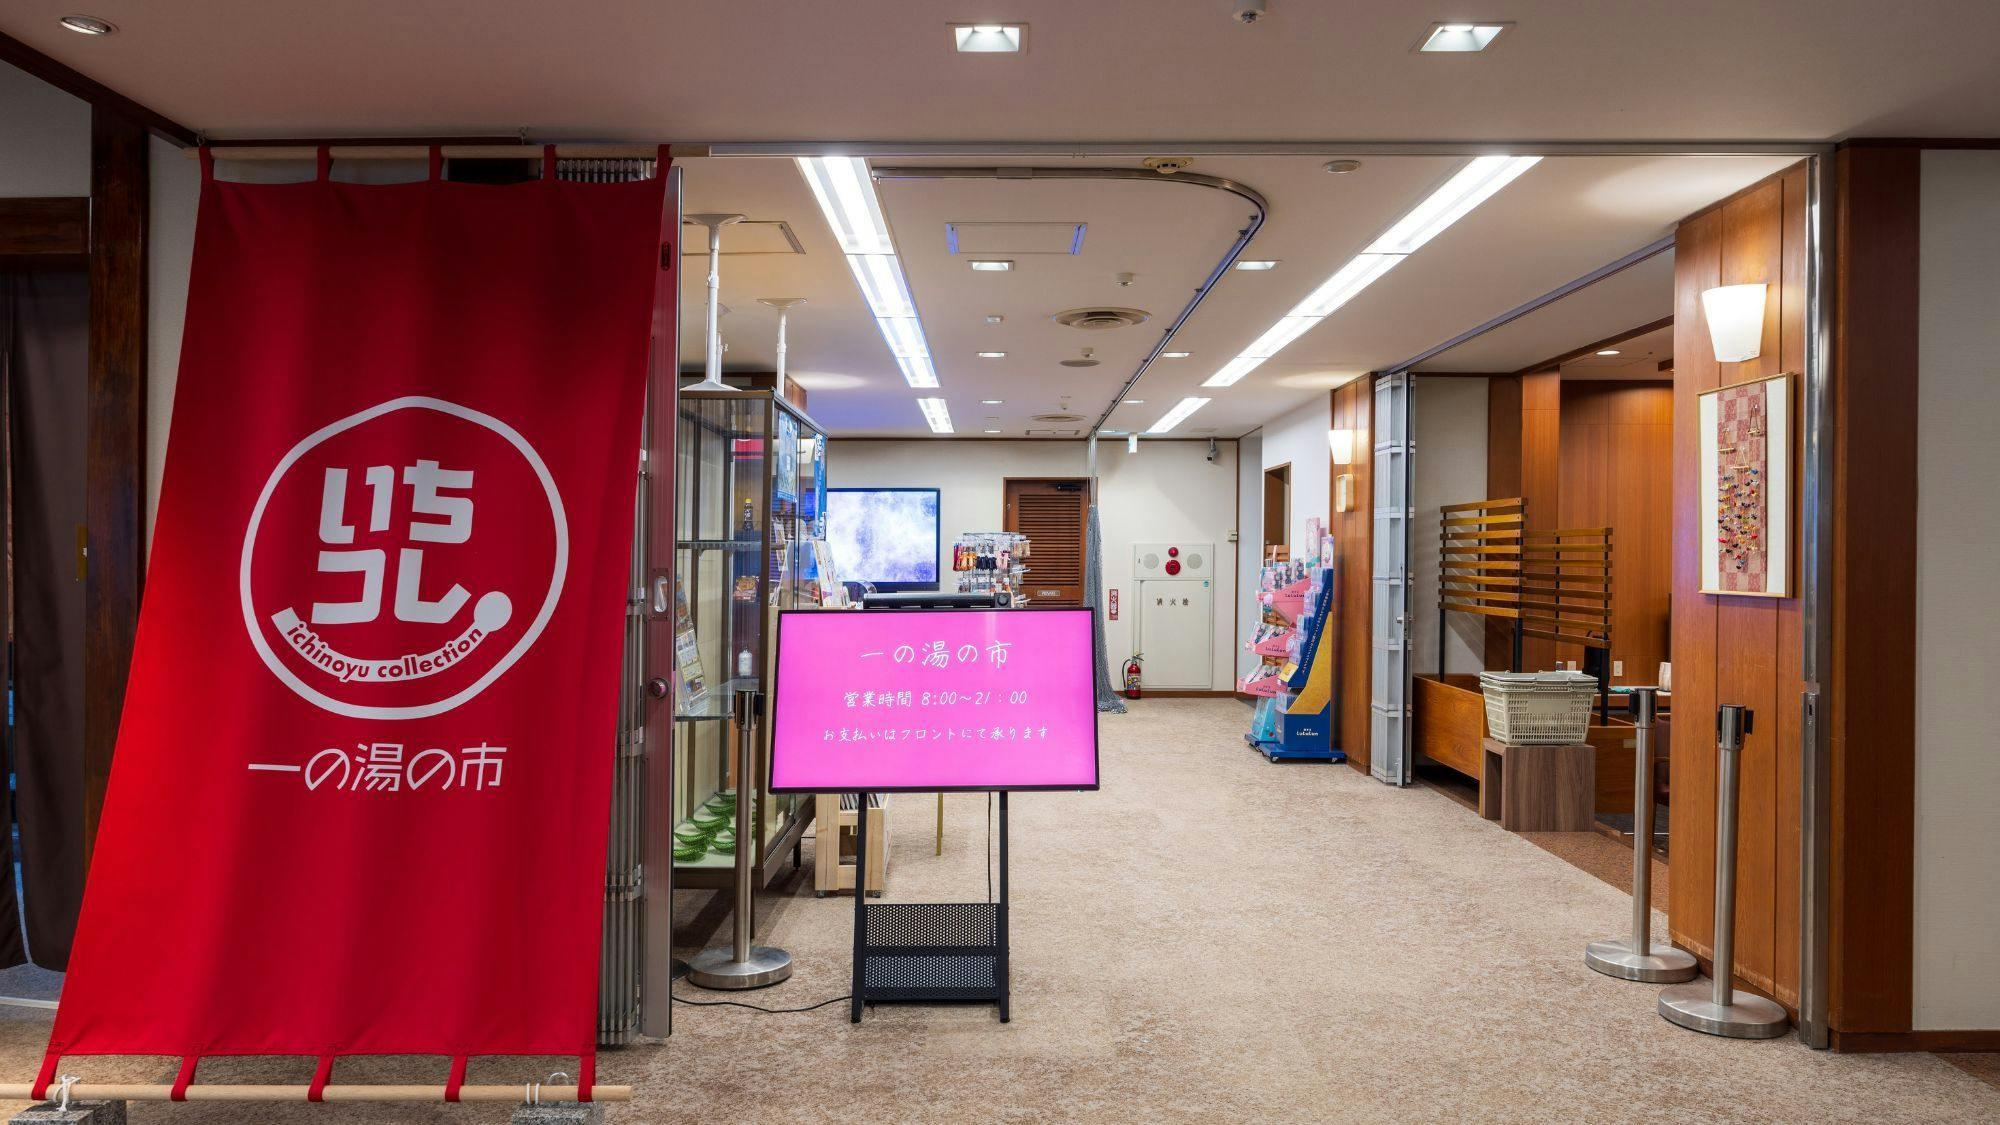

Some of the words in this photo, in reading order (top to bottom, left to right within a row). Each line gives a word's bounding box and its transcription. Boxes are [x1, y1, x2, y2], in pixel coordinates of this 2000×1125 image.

[318, 459, 474, 544] いち
[311, 548, 472, 625] コレ
[287, 621, 371, 683] ichinoyu
[376, 627, 484, 679] collection
[860, 640, 1012, 669] 一の湯の市
[843, 691, 912, 708] 営業時間
[823, 726, 1049, 742] お支払いはフロントにて承ります
[248, 742, 508, 792] 一の湯の市
